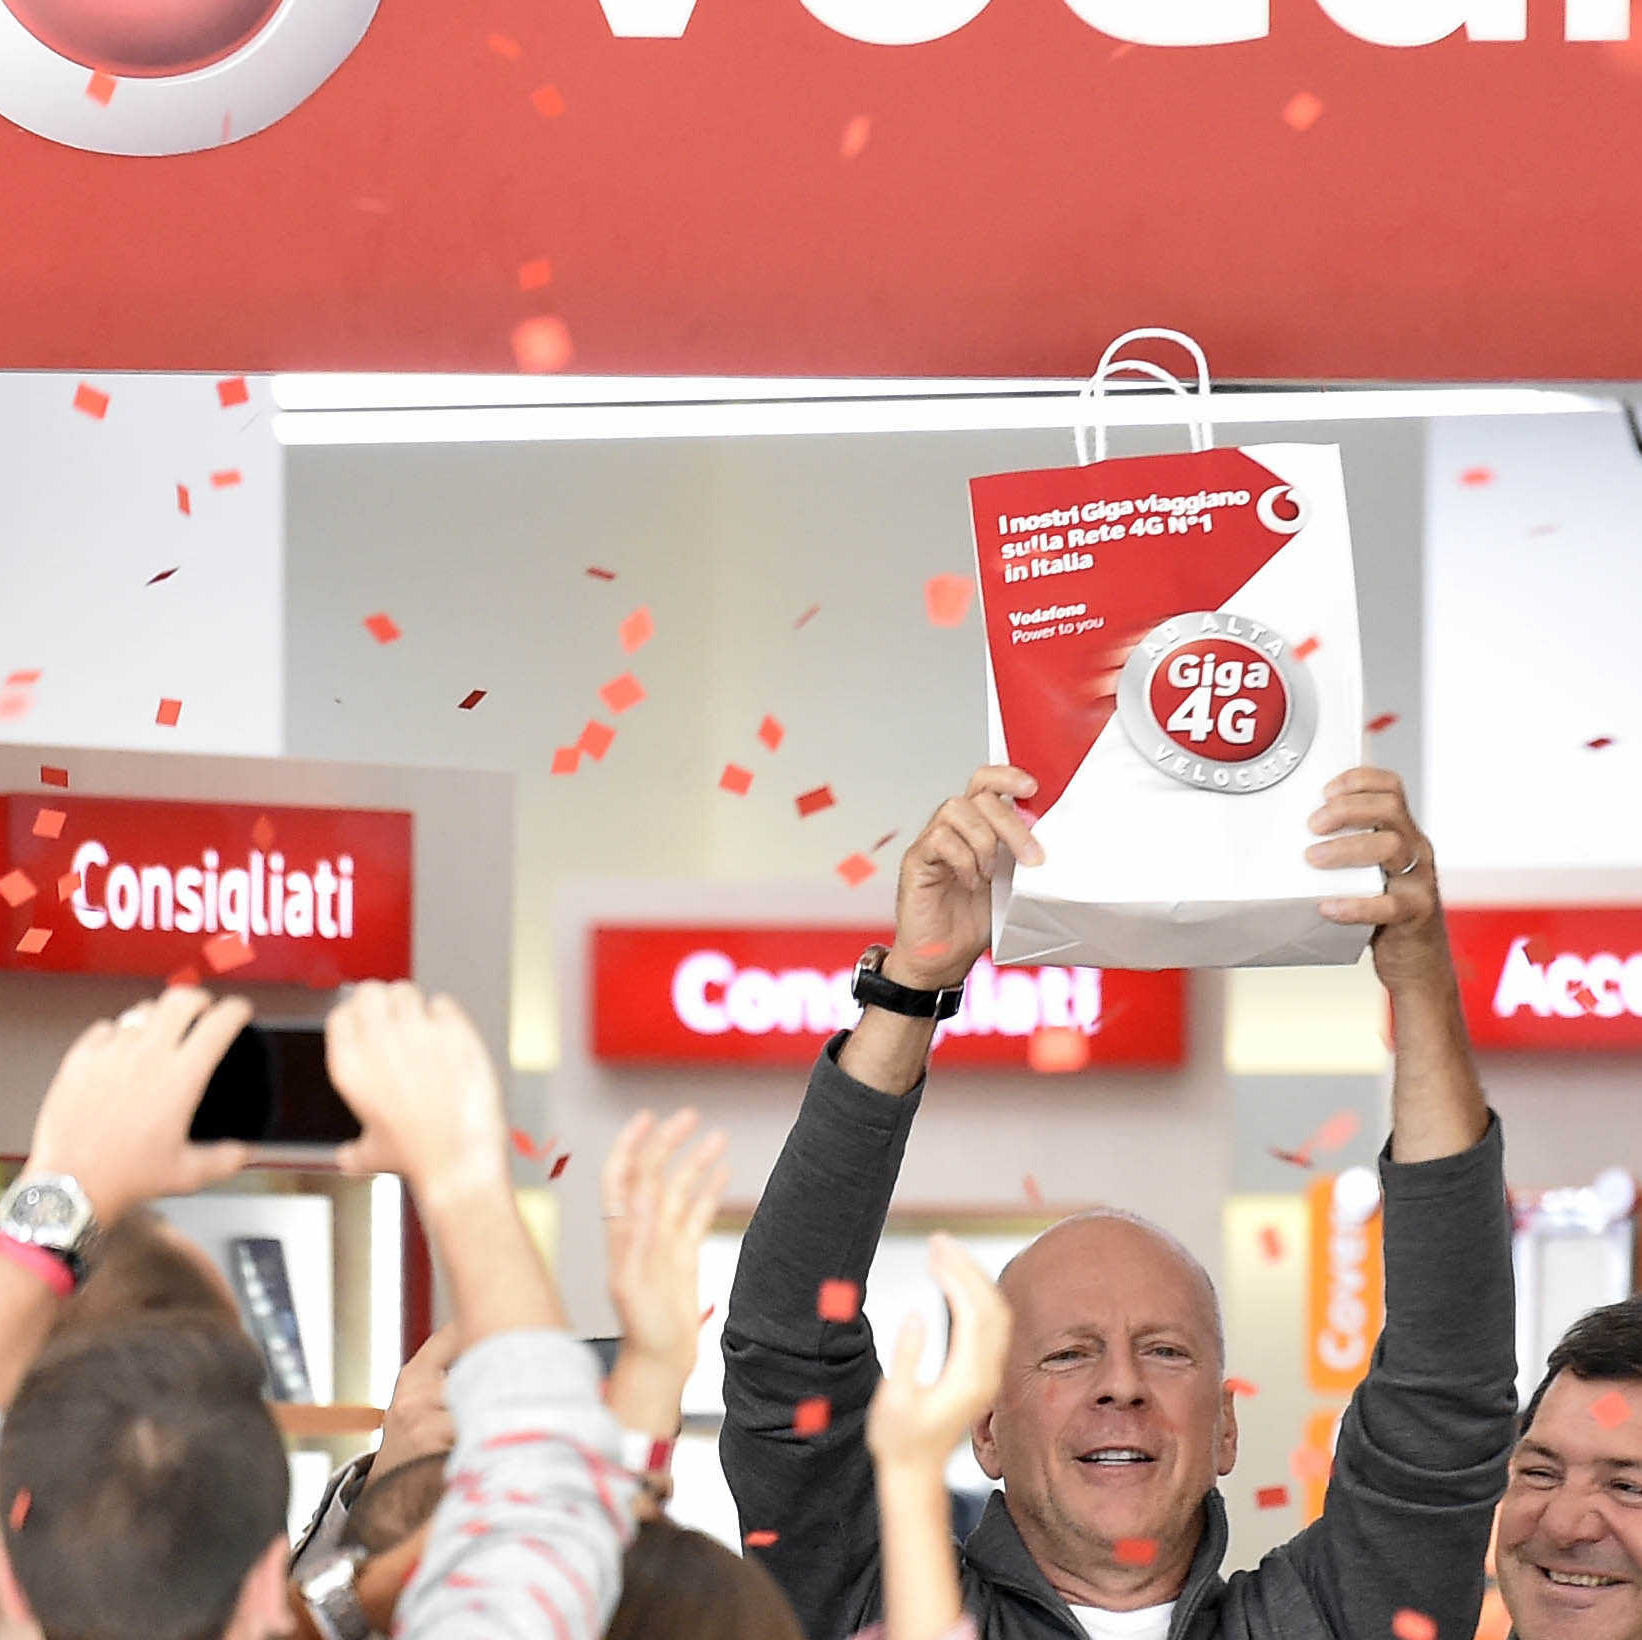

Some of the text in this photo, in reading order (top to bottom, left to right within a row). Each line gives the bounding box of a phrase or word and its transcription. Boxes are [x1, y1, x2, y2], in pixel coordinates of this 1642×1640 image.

[1009, 502, 1080, 533] nostri
[1082, 500, 1134, 523] Giga
[1135, 490, 1250, 515] viaggiano
[1000, 532, 1064, 560] sulla
[1067, 523, 1126, 548] Rete
[1128, 515, 1166, 537] 4G
[1004, 551, 1094, 583] in Italia
[1009, 603, 1086, 627] Vodafone
[1011, 615, 1105, 645] Power to you
[1200, 614, 1285, 658] ALTA
[1167, 652, 1272, 698] Giga
[1166, 686, 1258, 745] 4G
[71, 840, 354, 946] Consigliati
